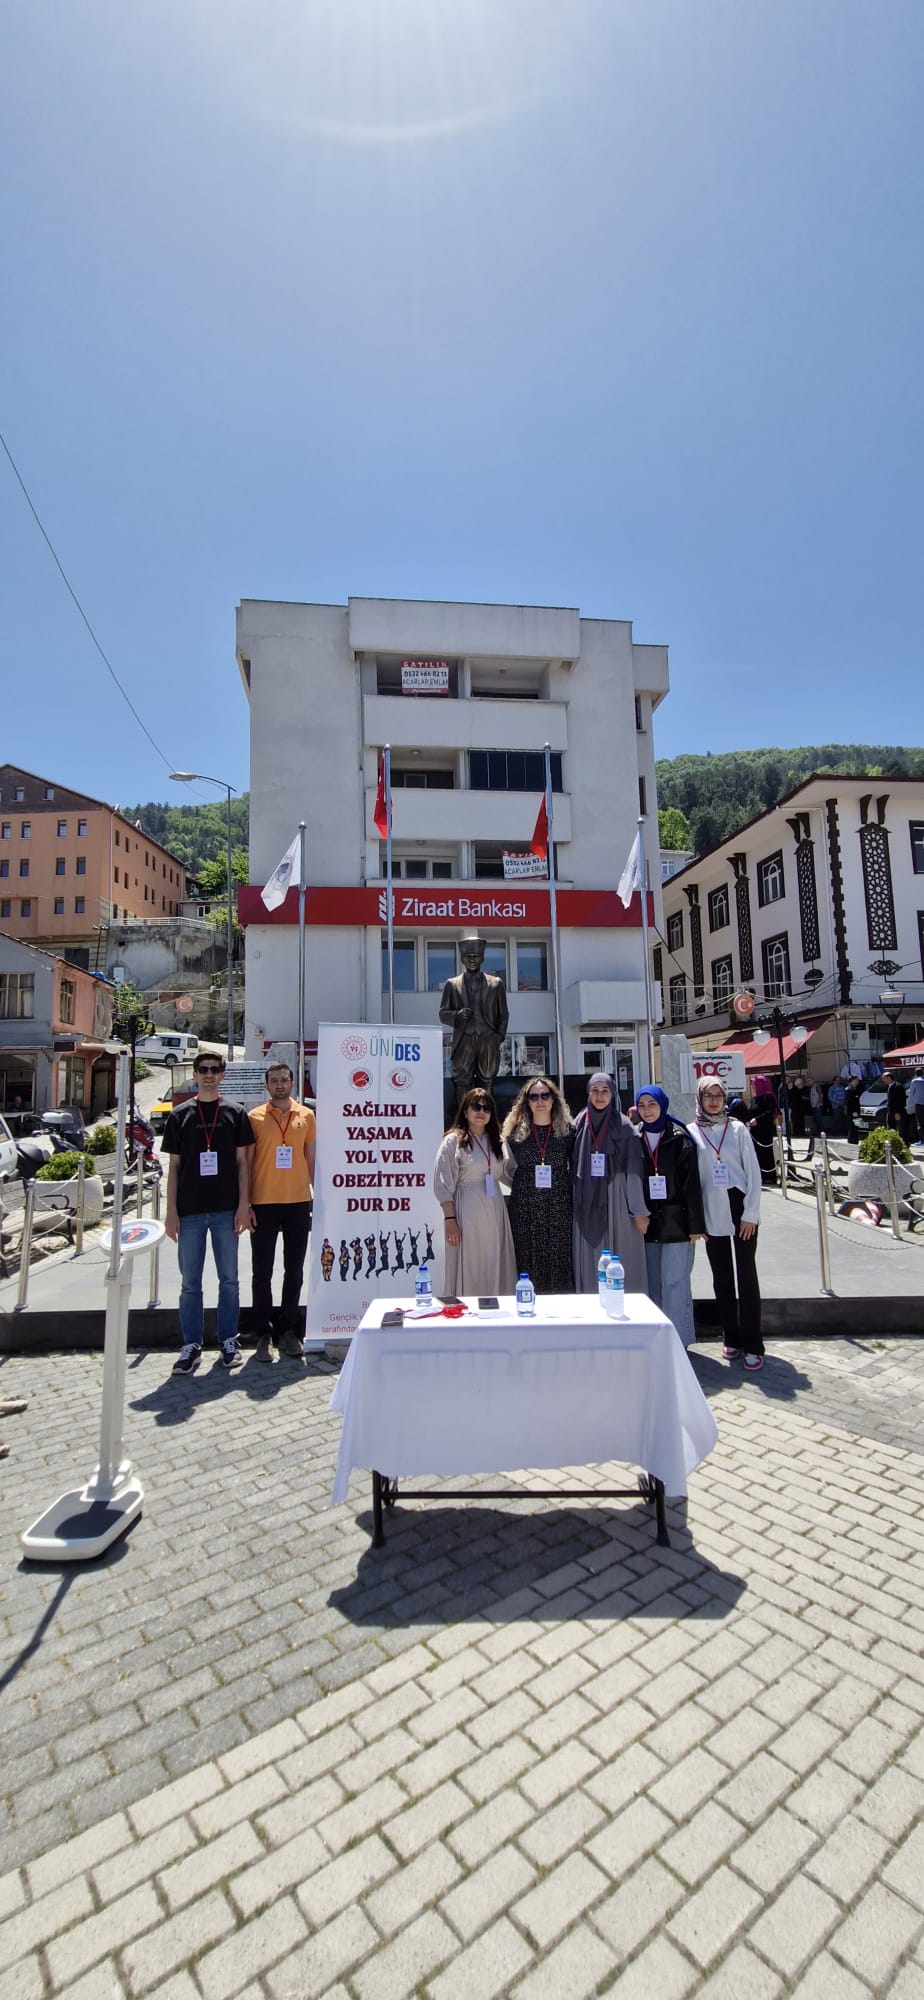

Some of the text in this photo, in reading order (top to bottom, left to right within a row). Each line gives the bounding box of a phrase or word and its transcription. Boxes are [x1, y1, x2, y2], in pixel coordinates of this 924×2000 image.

[401, 897, 526, 918] Ziraat Bankası
[342, 1101, 417, 1117] SAĞLIKLI
[346, 1127, 413, 1143] YAŞAMA
[344, 1150, 414, 1164] YOL VER
[332, 1171, 426, 1188] OBEZİTEYE
[346, 1198, 411, 1212] DUR DE
[329, 1313, 357, 1322] Gençlik
[322, 1325, 358, 1333] tarafında
